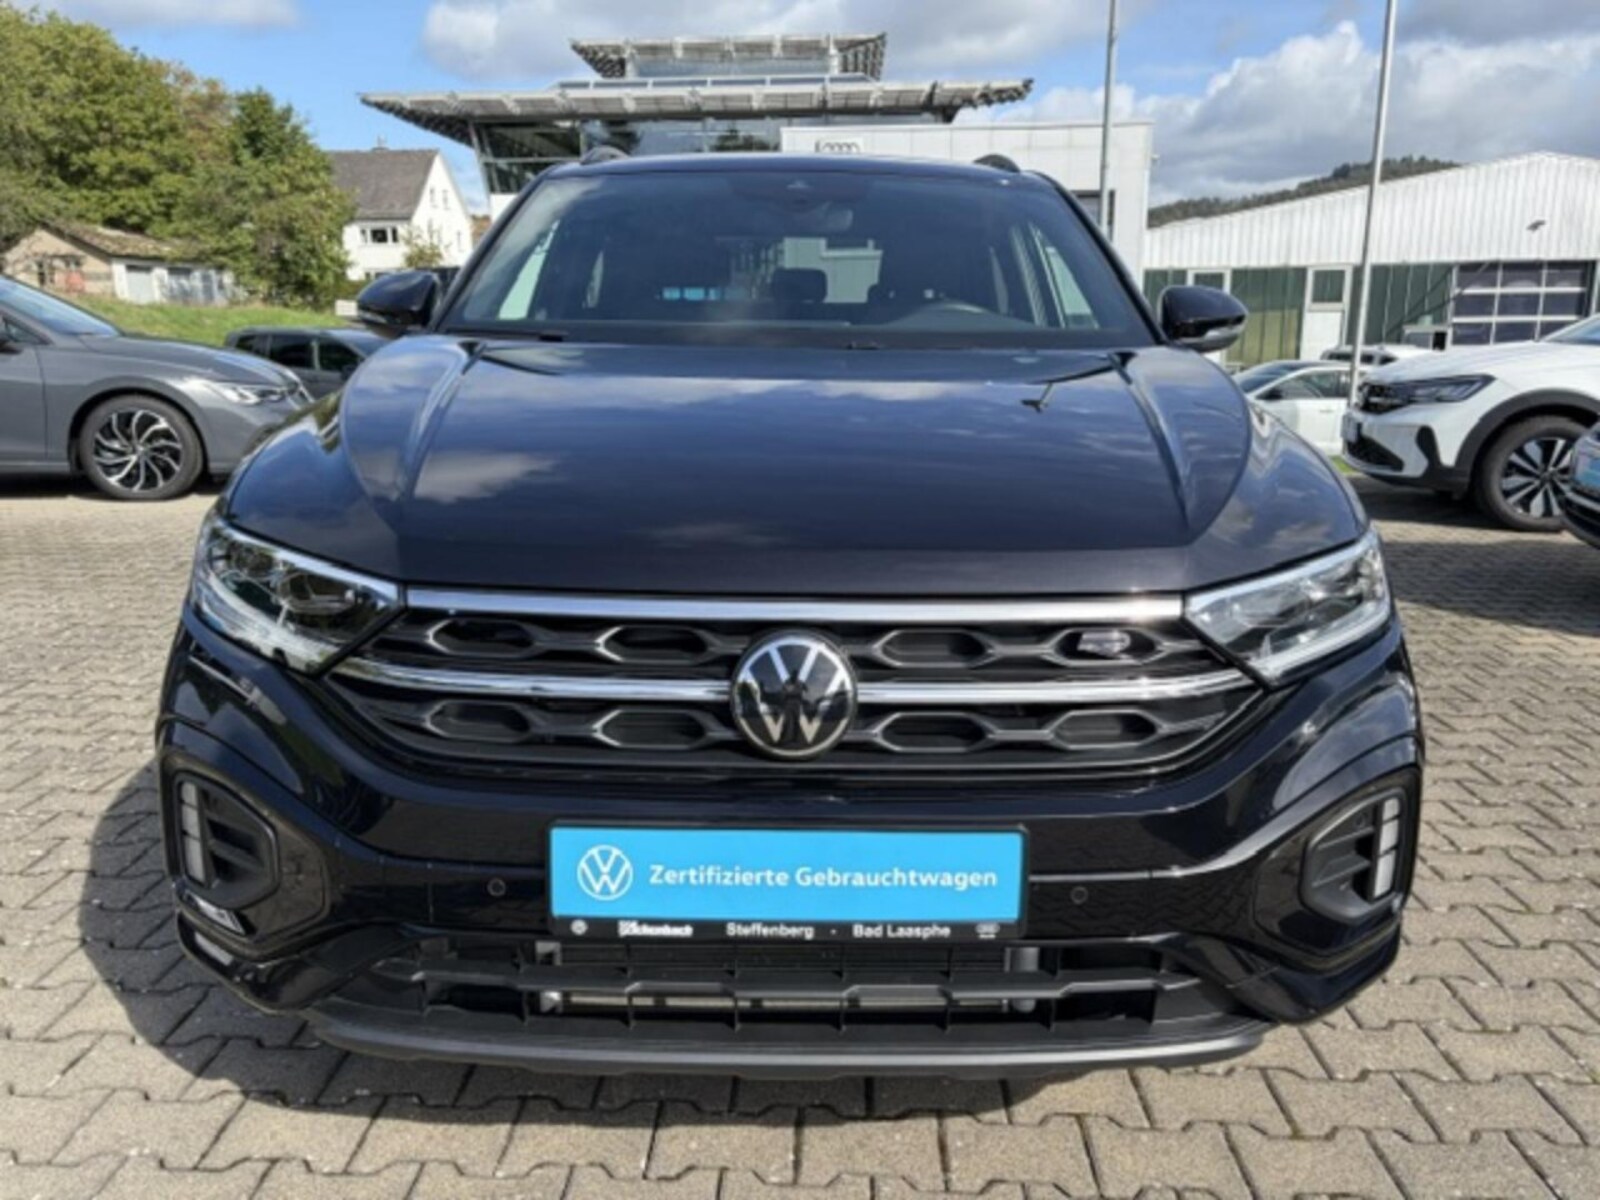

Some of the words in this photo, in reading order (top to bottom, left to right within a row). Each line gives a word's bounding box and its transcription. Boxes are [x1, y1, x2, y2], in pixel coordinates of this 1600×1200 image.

[577, 845, 633, 900] VW
[649, 865, 789, 886] Zertifizierte
[795, 866, 998, 891] Gebrauchtwagen
[853, 925, 881, 937] Bad
[886, 925, 951, 939] Laasphe
